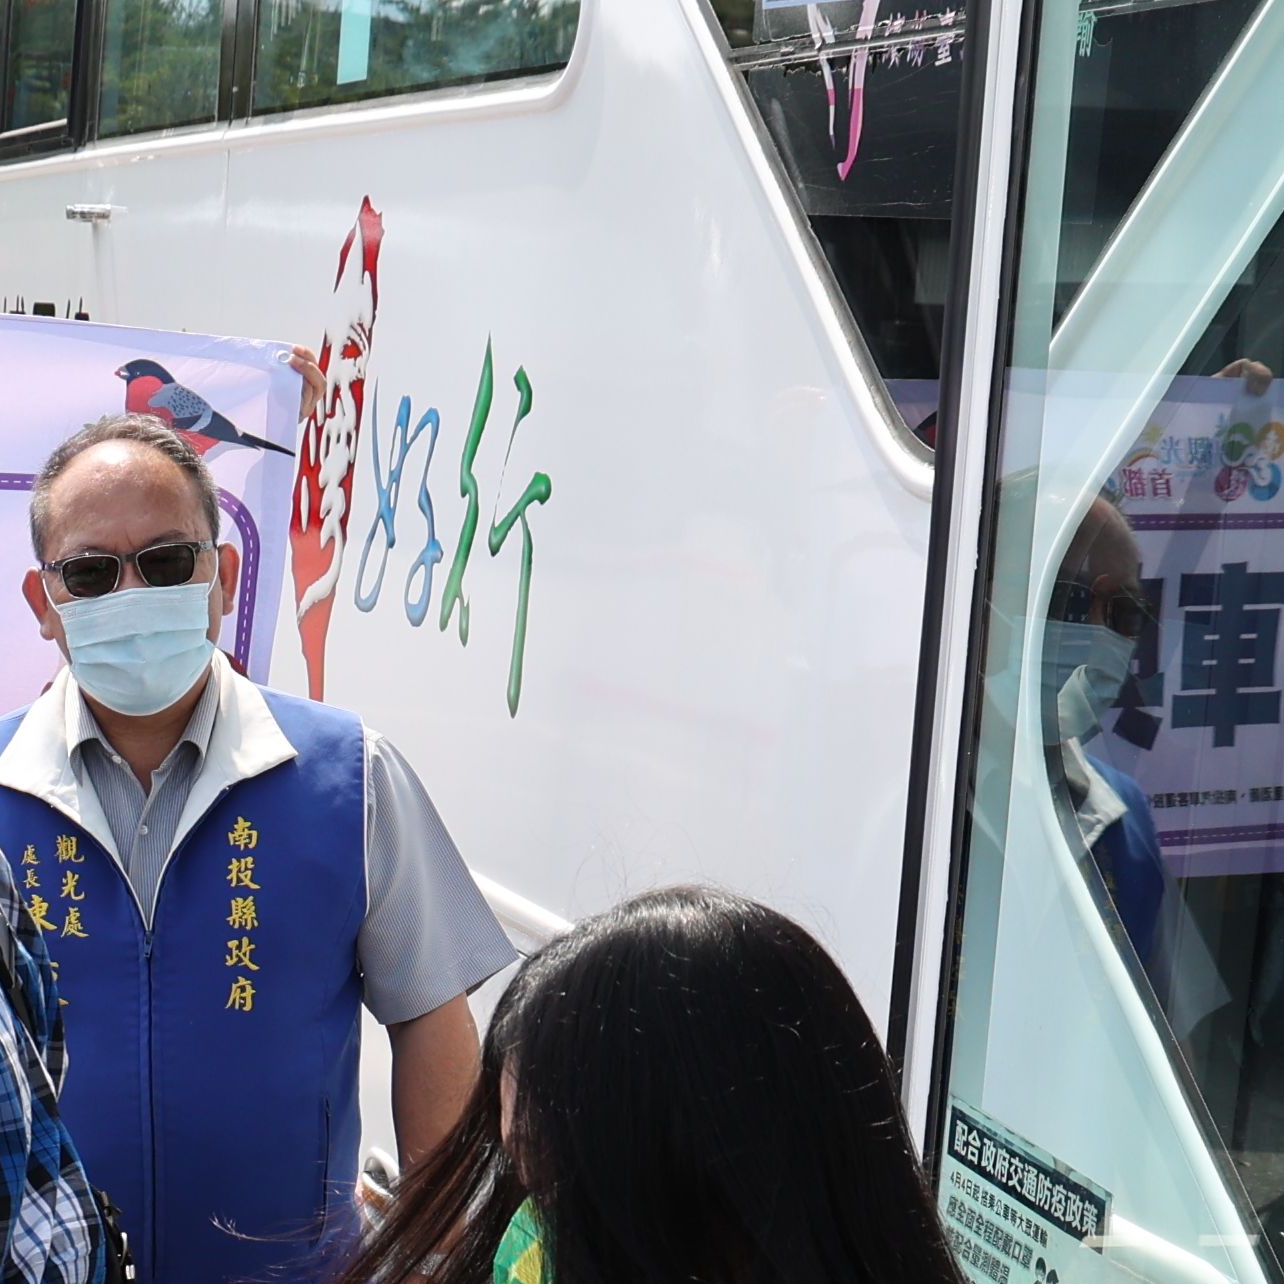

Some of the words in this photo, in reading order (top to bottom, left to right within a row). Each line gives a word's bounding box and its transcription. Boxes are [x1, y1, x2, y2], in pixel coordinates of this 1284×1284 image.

[20, 844, 41, 889] 處長
[54, 835, 90, 938] 觀光處
[225, 816, 261, 1012] 南投縣政府
[954, 1119, 1099, 1239] 配合政府交通防疫政策
